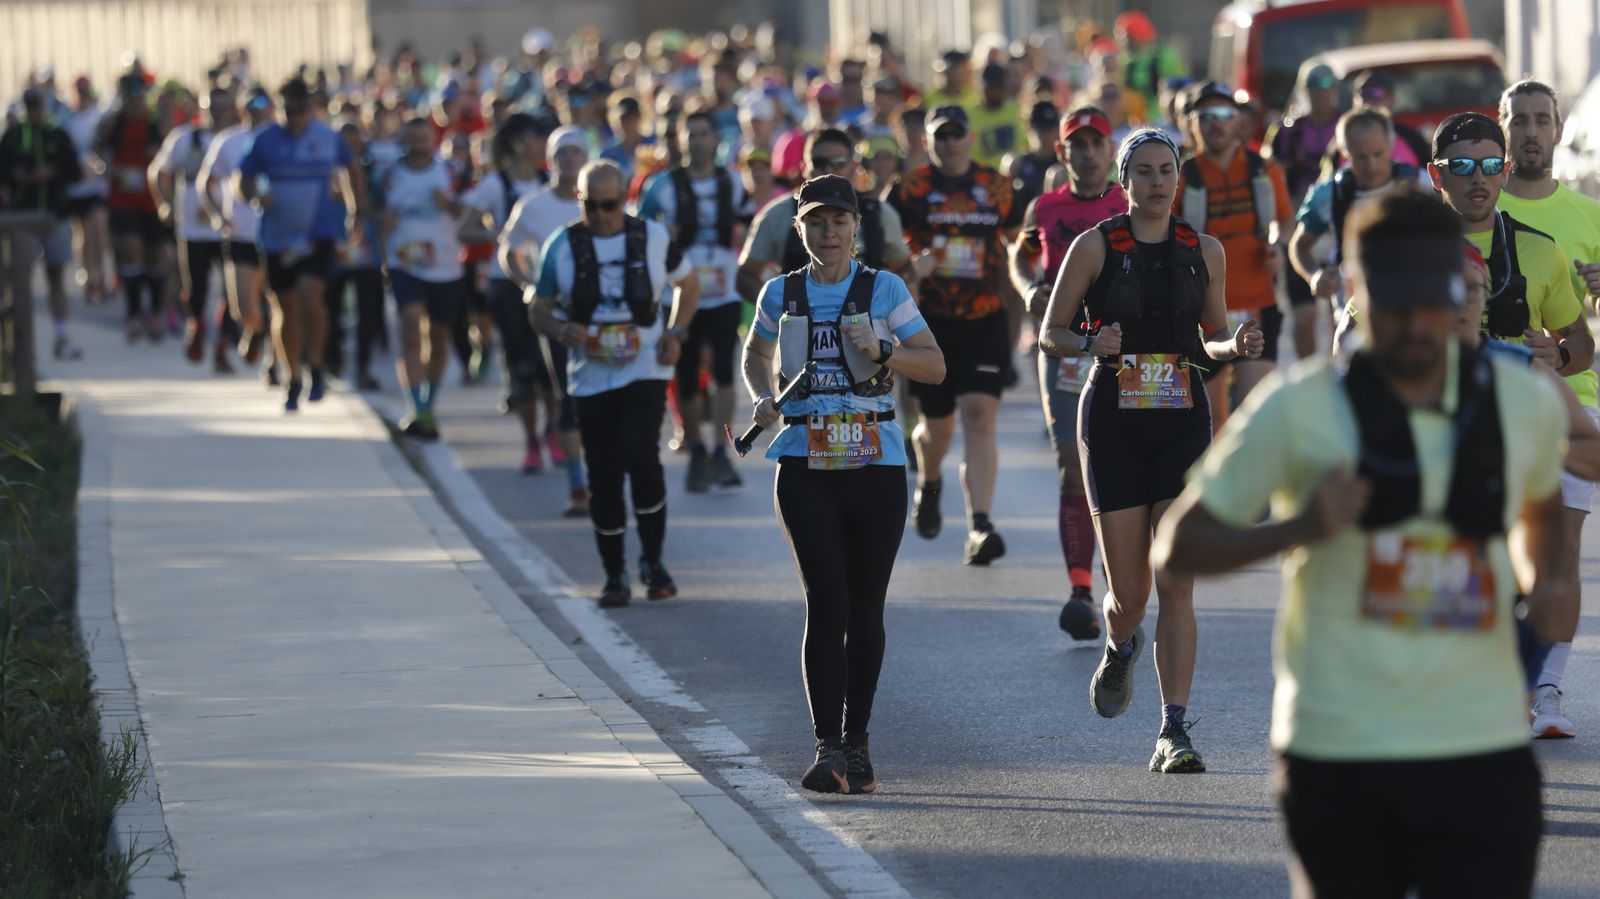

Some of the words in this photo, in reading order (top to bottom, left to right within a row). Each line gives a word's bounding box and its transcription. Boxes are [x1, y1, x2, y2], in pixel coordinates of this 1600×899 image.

[1140, 362, 1174, 382] 322
[1121, 389, 1170, 397] Carbonerilla
[1171, 389, 1188, 397] 2023
[827, 423, 863, 443] 388
[810, 450, 858, 458] Carbonerilla
[860, 447, 878, 456] 2023
